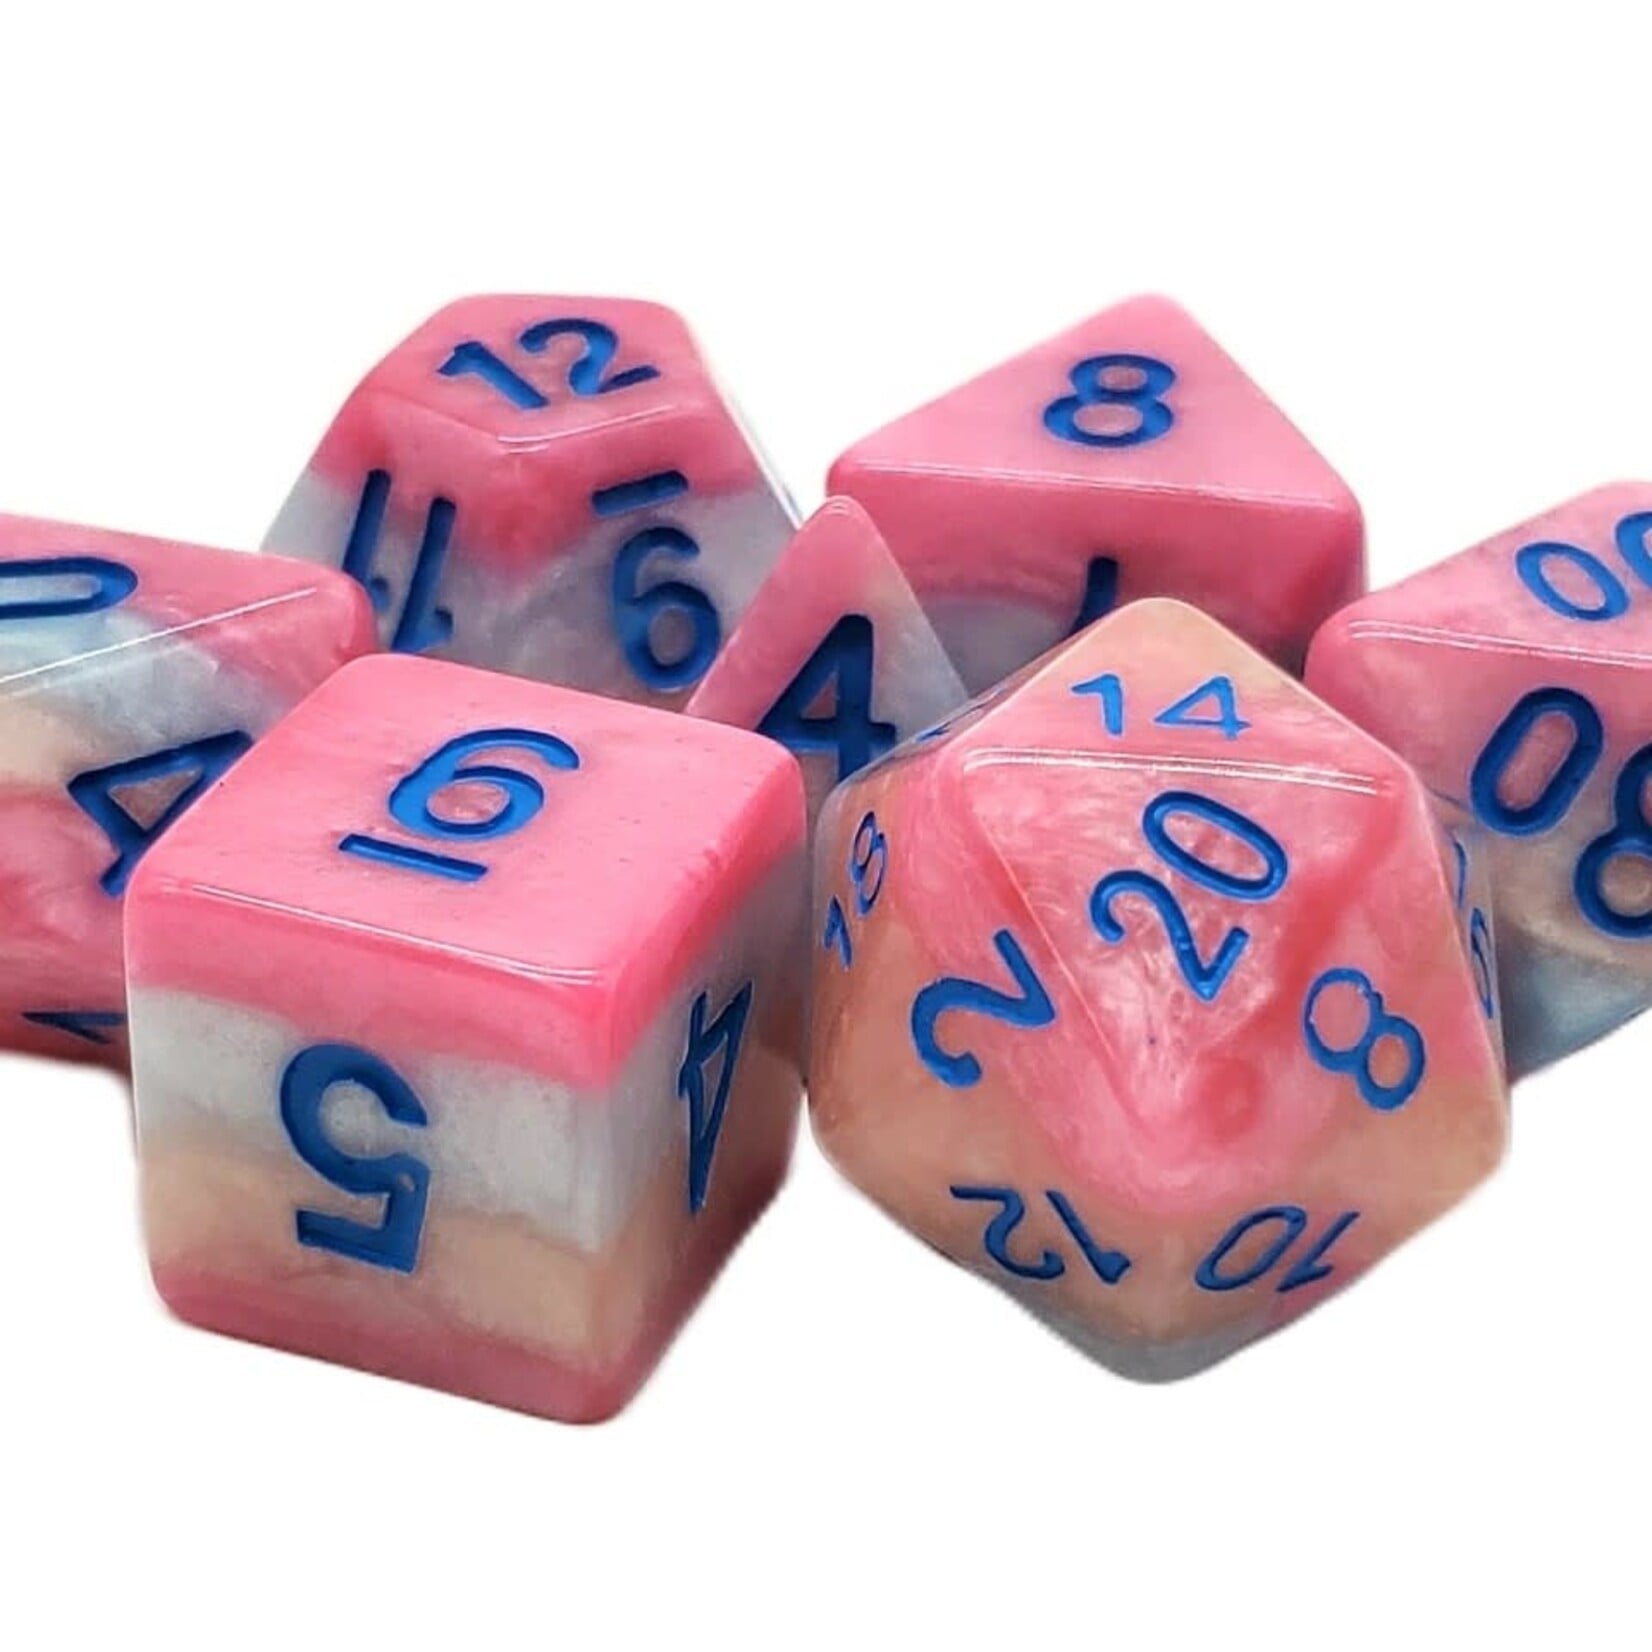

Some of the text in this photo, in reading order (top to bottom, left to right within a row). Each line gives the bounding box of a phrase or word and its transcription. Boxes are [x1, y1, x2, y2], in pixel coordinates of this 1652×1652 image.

[440, 318, 659, 410] 12
[1042, 353, 1177, 448] 8
[758, 613, 898, 784] 4
[1070, 672, 1252, 738] 14
[339, 727, 581, 883] 6
[823, 810, 890, 972] 18
[1089, 790, 1289, 1001] 20
[910, 929, 1057, 1089] 2
[1303, 967, 1426, 1111] 8
[277, 1044, 431, 1274] 5
[677, 985, 753, 1213] 4
[948, 1184, 1131, 1284] 12
[1194, 1204, 1361, 1294] 10
